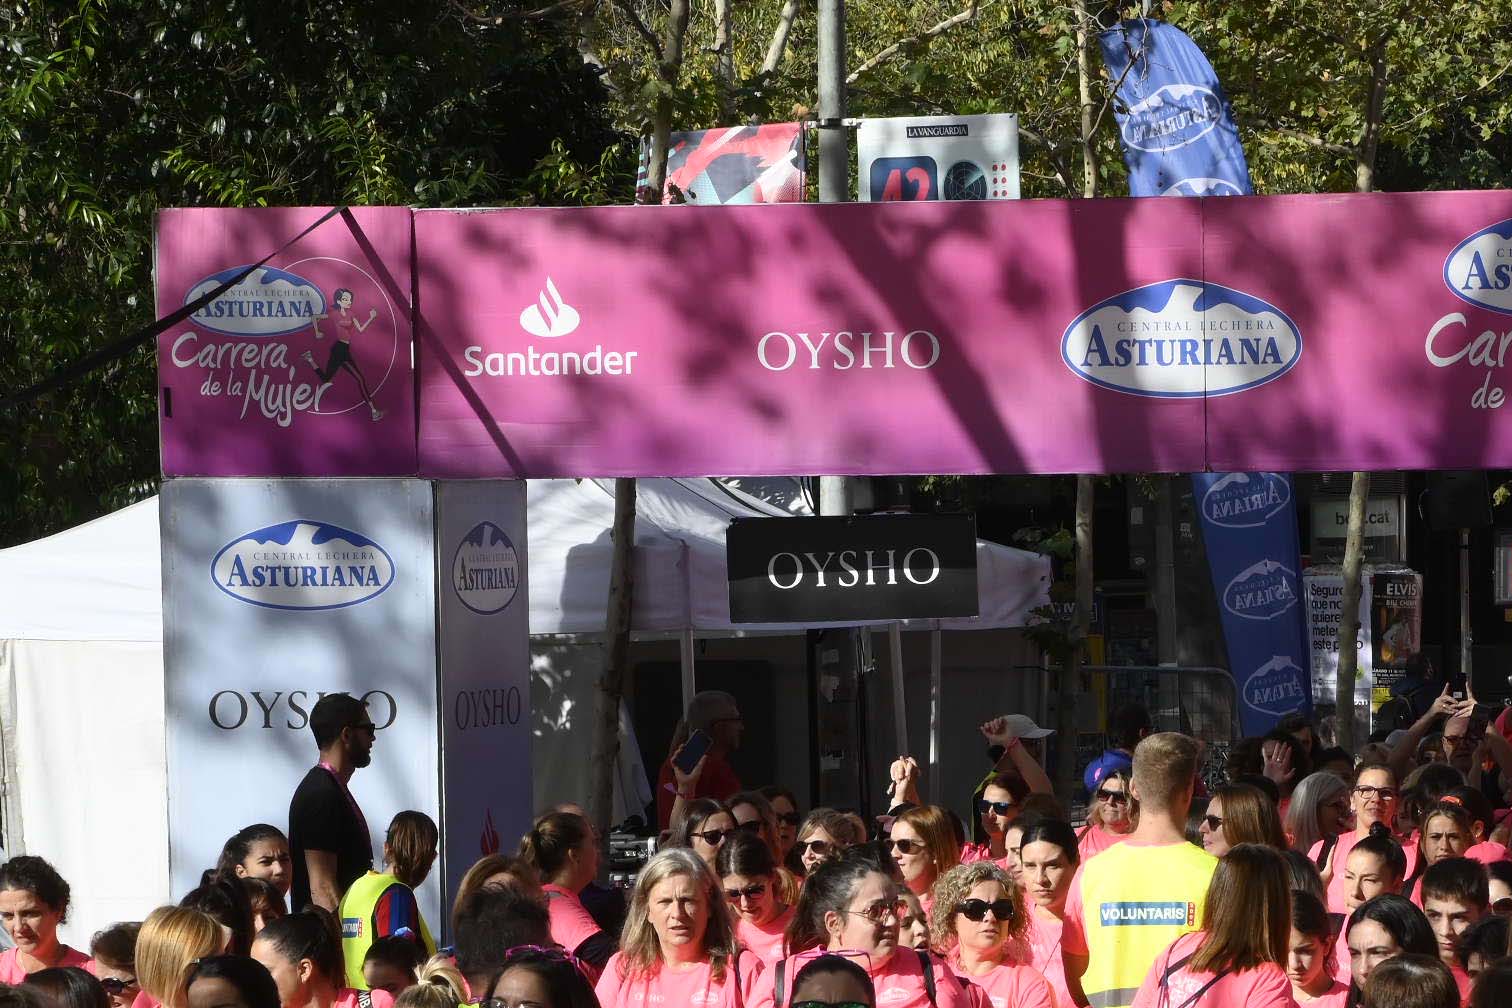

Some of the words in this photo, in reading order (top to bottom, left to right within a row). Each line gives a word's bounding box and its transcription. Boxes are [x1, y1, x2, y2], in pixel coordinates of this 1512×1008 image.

[907, 127, 919, 137] LA
[919, 125, 968, 137] VANGUARDIA
[194, 291, 315, 318] ASTURIANA
[221, 290, 261, 298] ENTRAL
[264, 289, 312, 298] LECHERA
[1117, 319, 1193, 333] CENTRAL
[1200, 319, 1276, 332] LECHERA
[171, 331, 289, 369] Carrera
[464, 345, 638, 378] Santander
[757, 329, 940, 372] OYSHO
[1081, 321, 1283, 367] ASTURIANA
[200, 372, 222, 396] de
[227, 371, 243, 396] la
[239, 365, 333, 428] Mujer
[1471, 369, 1505, 409] de
[225, 553, 381, 588] ASTURIANA
[254, 551, 311, 562] CENTRAL
[317, 551, 375, 562] LECHERA
[458, 555, 516, 592] ASTURIANA
[768, 547, 940, 589] OYSHO
[1311, 600, 1328, 612] que
[1386, 583, 1417, 597] ELVIS
[209, 689, 397, 731] OYSO
[455, 686, 521, 731] OYSHO
[1101, 906, 1185, 921] VOLUNTARIS
